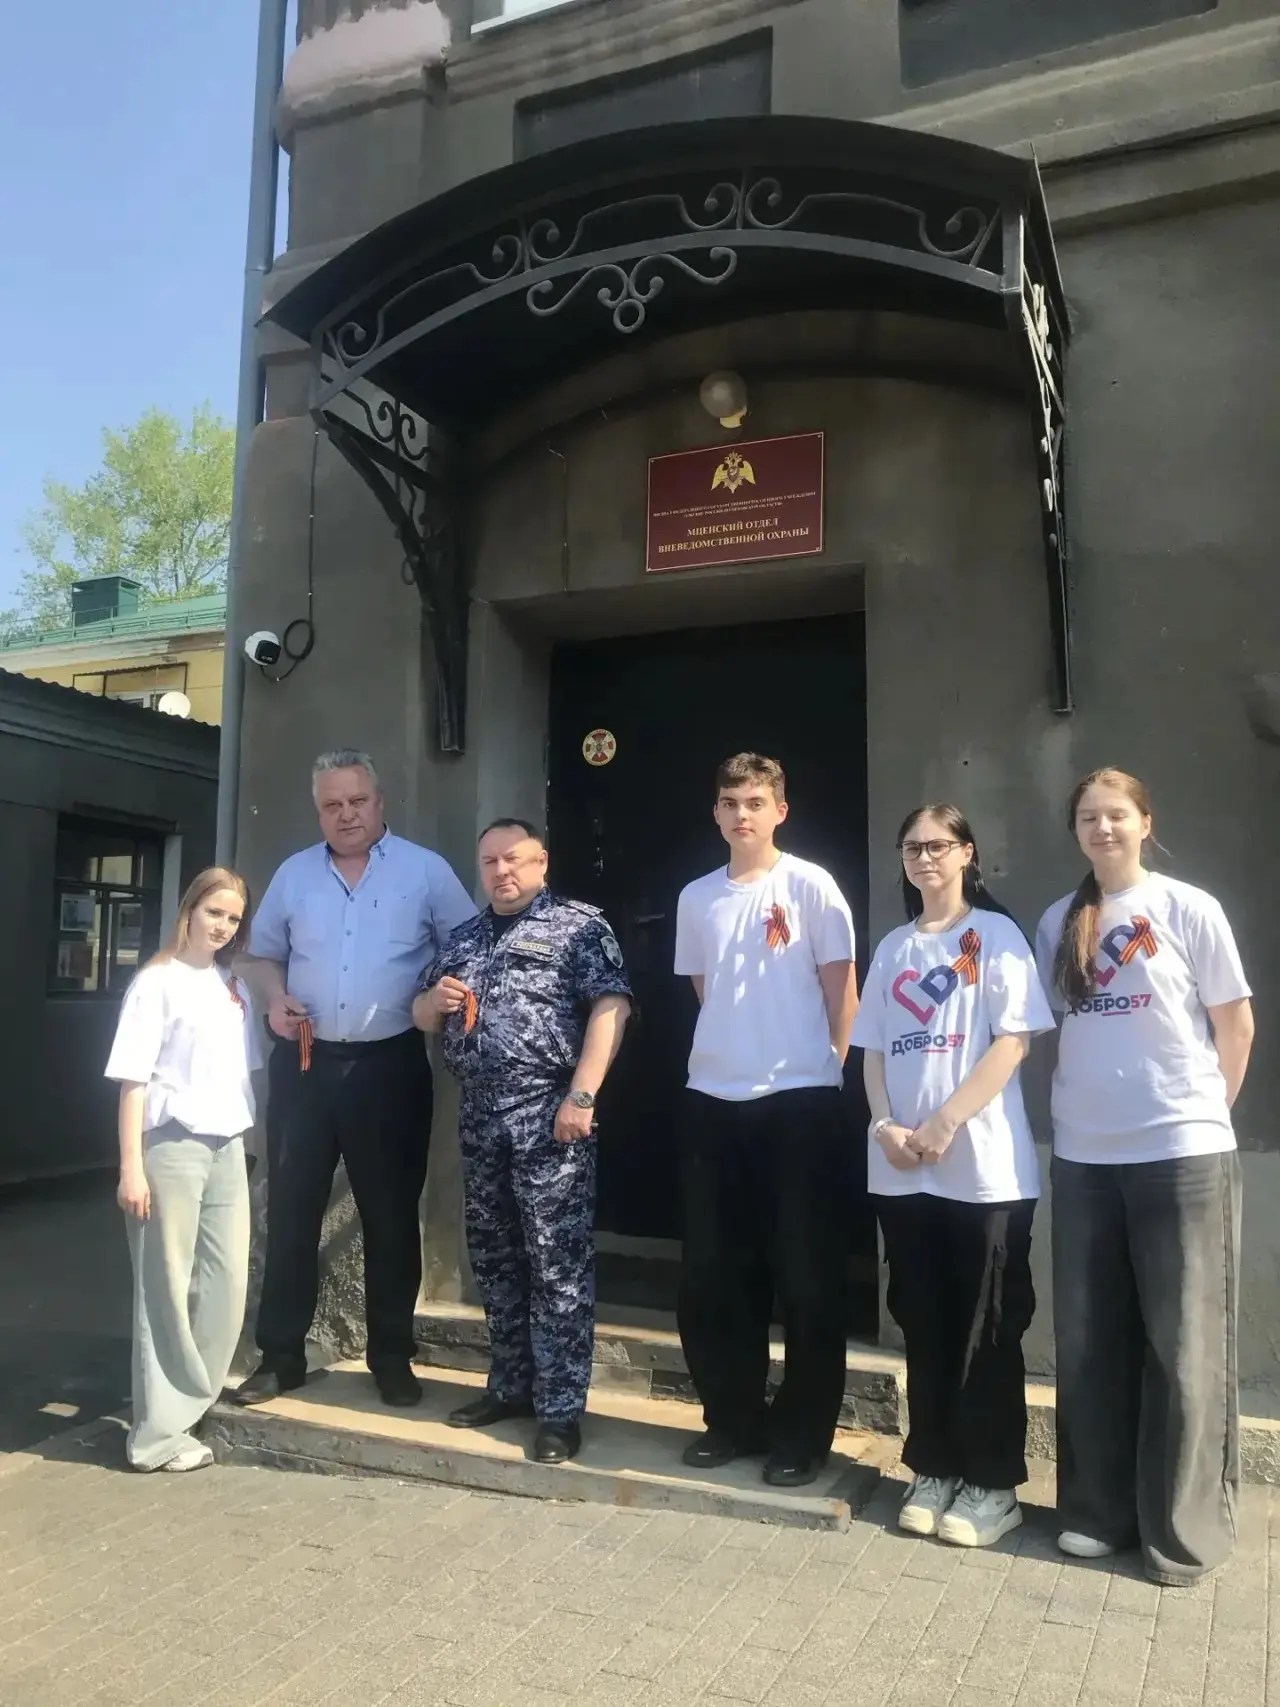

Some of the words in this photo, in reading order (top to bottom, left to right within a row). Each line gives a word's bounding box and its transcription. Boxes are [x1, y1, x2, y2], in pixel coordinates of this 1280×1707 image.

[687, 521, 743, 537] МЦЕНСКИЙ
[745, 518, 779, 530] ОТДЕЛ
[658, 531, 765, 553] ВНЕВЕДОМСТВЕННОЙ
[767, 527, 810, 540] ОХРАНЫ
[891, 1033, 966, 1056] ДОБРО57
